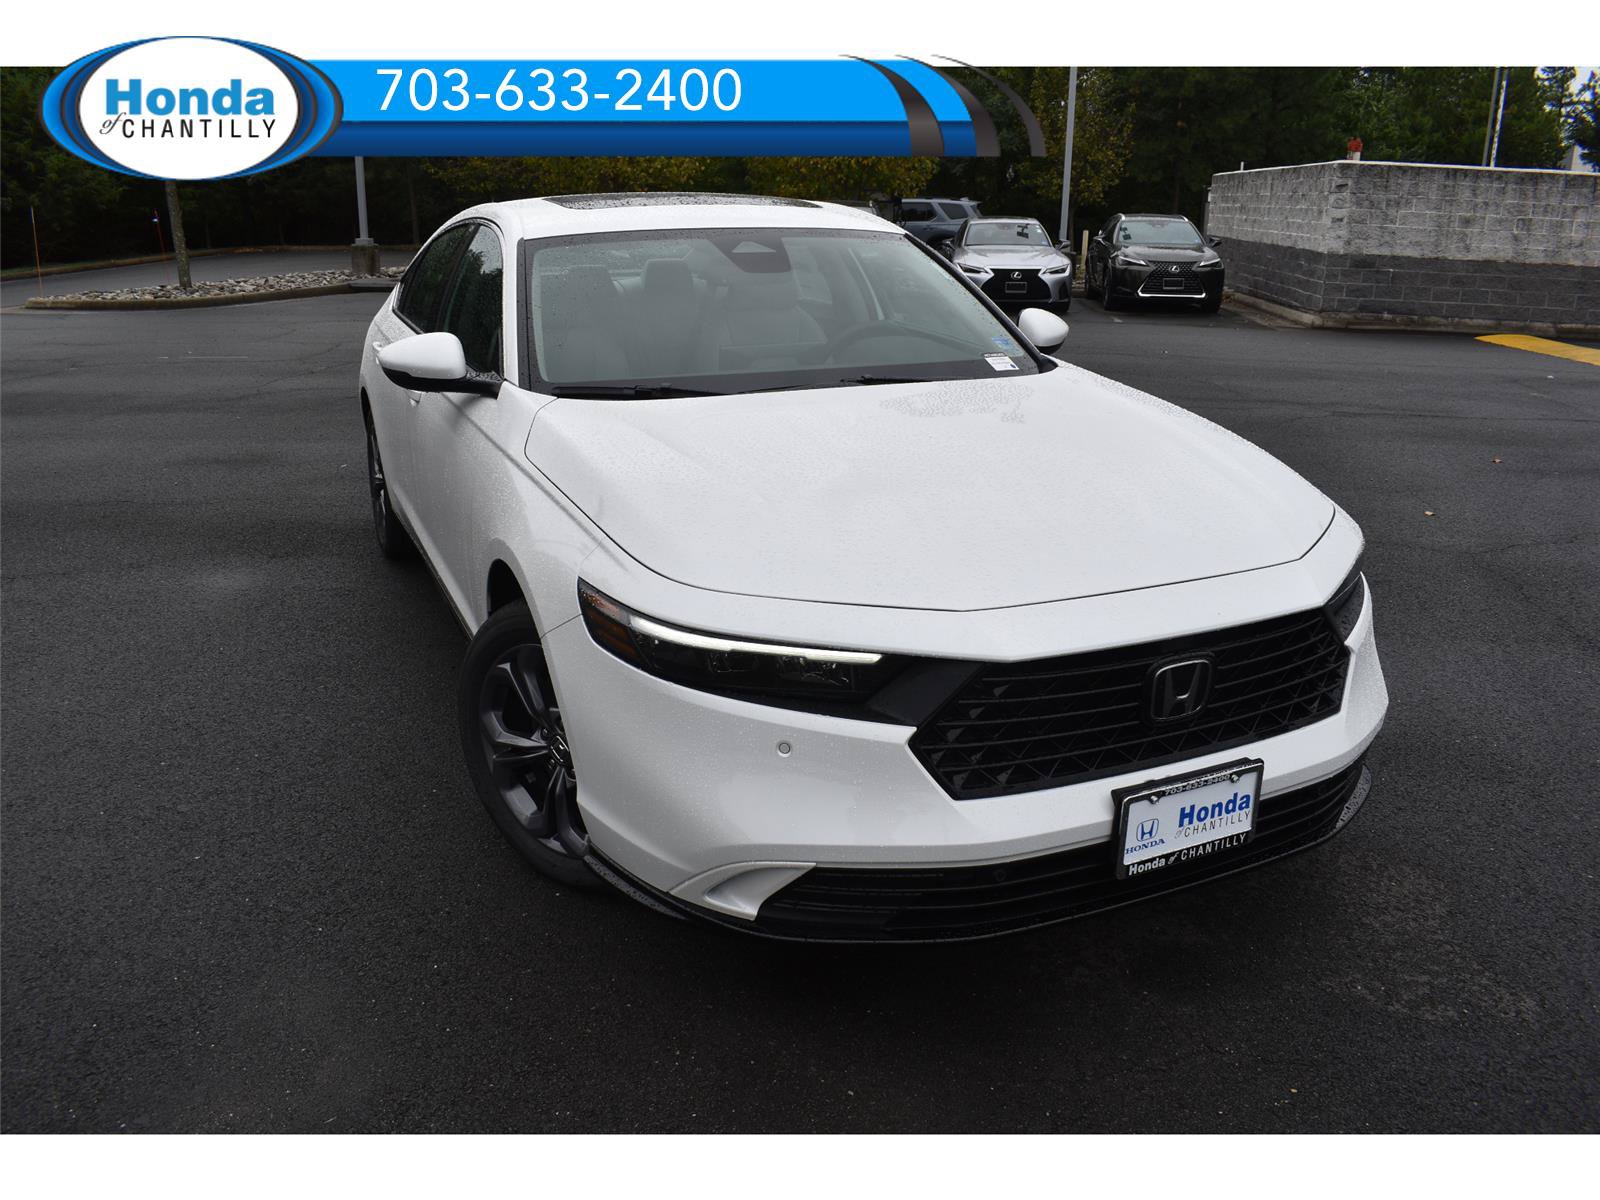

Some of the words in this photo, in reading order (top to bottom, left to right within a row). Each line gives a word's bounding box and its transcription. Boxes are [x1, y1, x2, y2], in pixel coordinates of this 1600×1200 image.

[1178, 792, 1251, 828] Honda
[1184, 811, 1251, 838] CHANTILLY
[1125, 838, 1166, 855] HONDA
[1128, 857, 1166, 876] Honda
[1181, 833, 1247, 861] CHANTILLY
